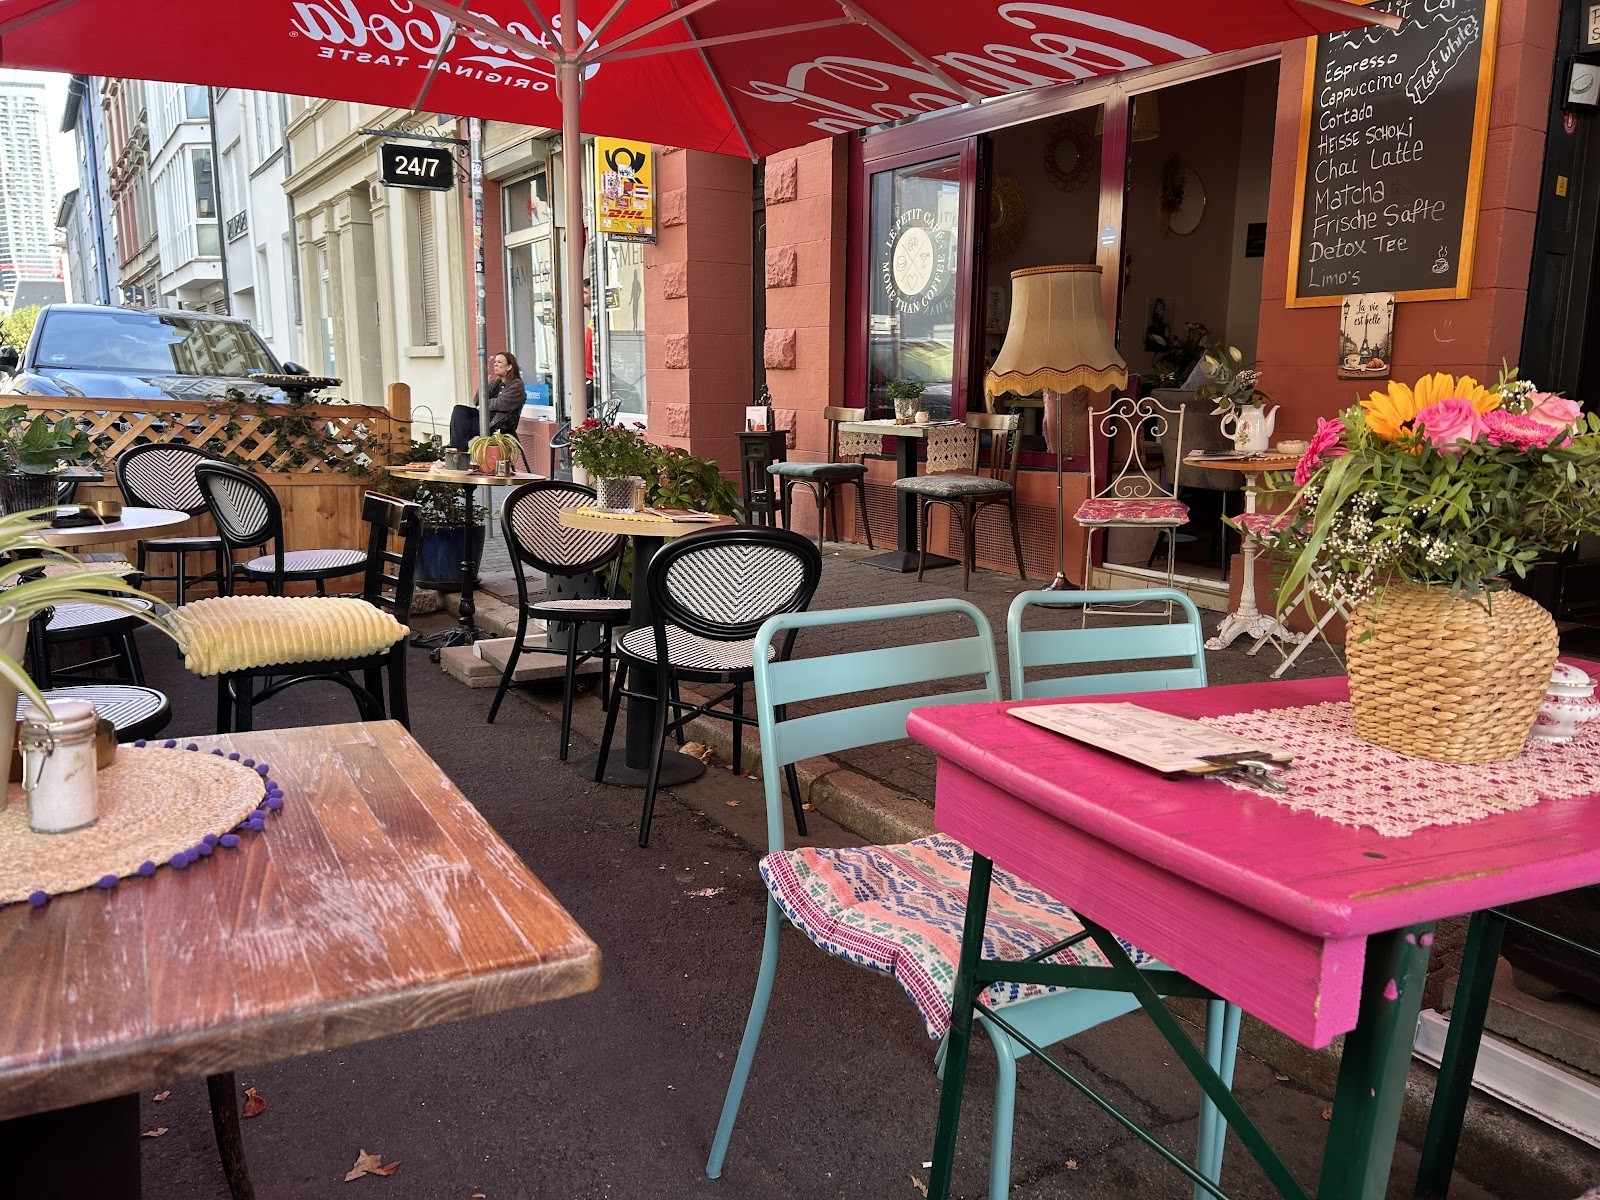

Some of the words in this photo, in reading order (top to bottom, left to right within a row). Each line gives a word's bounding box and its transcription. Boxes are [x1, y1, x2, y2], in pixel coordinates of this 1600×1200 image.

[1324, 53, 1398, 83] Espresso
[1413, 59, 1441, 101] Flat
[1320, 72, 1403, 108] Cappuccino
[1319, 103, 1373, 131] Cortado
[395, 155, 440, 177] 24/7
[1315, 153, 1358, 183] Chai
[1370, 140, 1424, 170] Latte
[1315, 180, 1385, 214] Matcha
[607, 209, 645, 220] DHL
[886, 227, 897, 249] LE
[895, 208, 923, 231] PETIT
[1312, 209, 1377, 238] Frische
[1309, 236, 1367, 263] Detox
[882, 262, 896, 301] MORE
[895, 297, 920, 314] THAN
[921, 253, 946, 308] COFFEE
[1354, 316, 1364, 326] est
[1365, 313, 1381, 326] belle
[1356, 299, 1366, 314] La
[1368, 302, 1379, 312] vie
